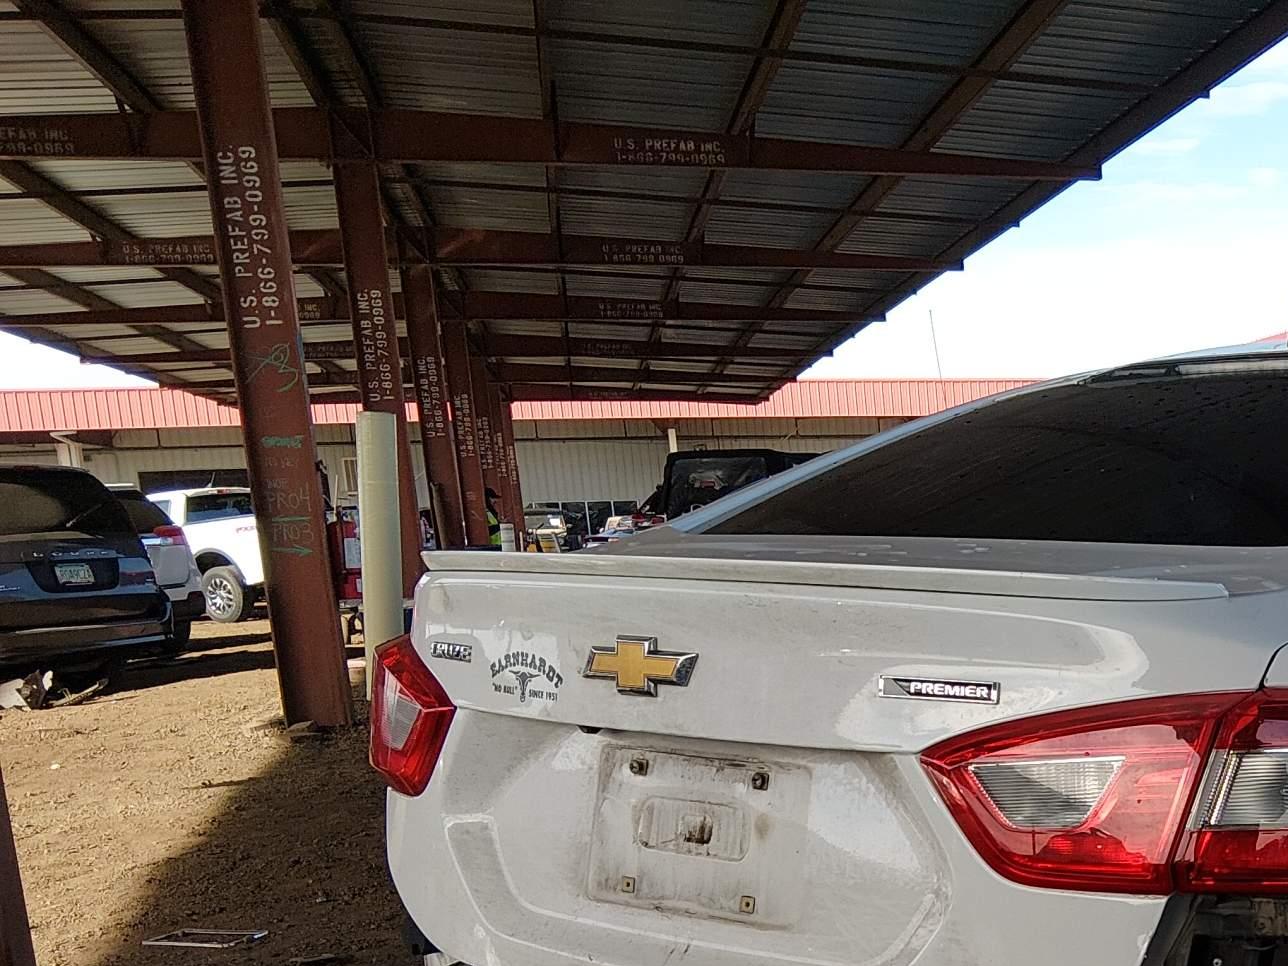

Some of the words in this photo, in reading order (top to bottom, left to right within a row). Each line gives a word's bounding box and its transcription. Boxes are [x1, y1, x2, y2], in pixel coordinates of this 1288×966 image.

[217, 145, 239, 184] INC.
[224, 196, 253, 277] PREFAB
[238, 146, 284, 326] 1-866-799-0969
[240, 289, 261, 329] U.S.
[357, 289, 370, 313] INC.
[361, 320, 377, 370] PREFAB
[370, 289, 395, 400] 1-866-799-0969
[368, 377, 380, 401] U.S.
[489, 651, 563, 689] EARNHARDT
[909, 681, 990, 698] PREMIER
[528, 689, 544, 699] SINCE
